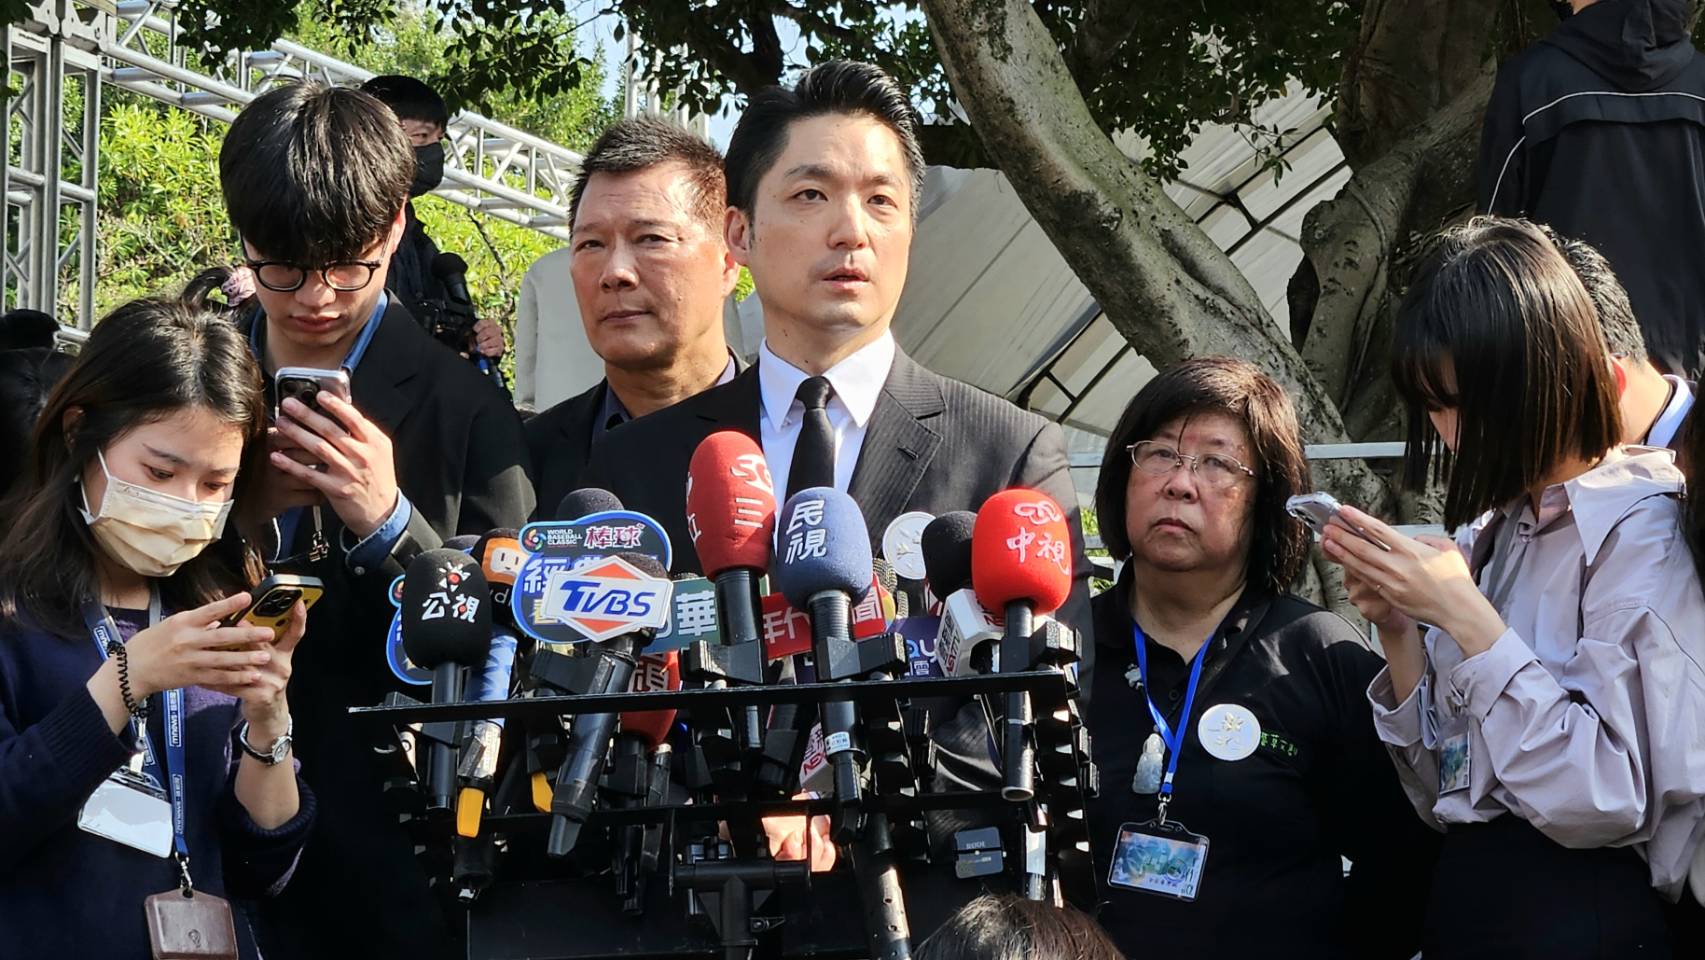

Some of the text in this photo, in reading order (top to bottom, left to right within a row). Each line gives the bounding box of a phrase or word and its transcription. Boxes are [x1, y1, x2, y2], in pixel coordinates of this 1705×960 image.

[584, 526, 642, 549] 棒球
[785, 499, 826, 564] 民視
[1006, 526, 1069, 575] 中視
[422, 592, 480, 623] 公視
[560, 580, 656, 616] TVBS
